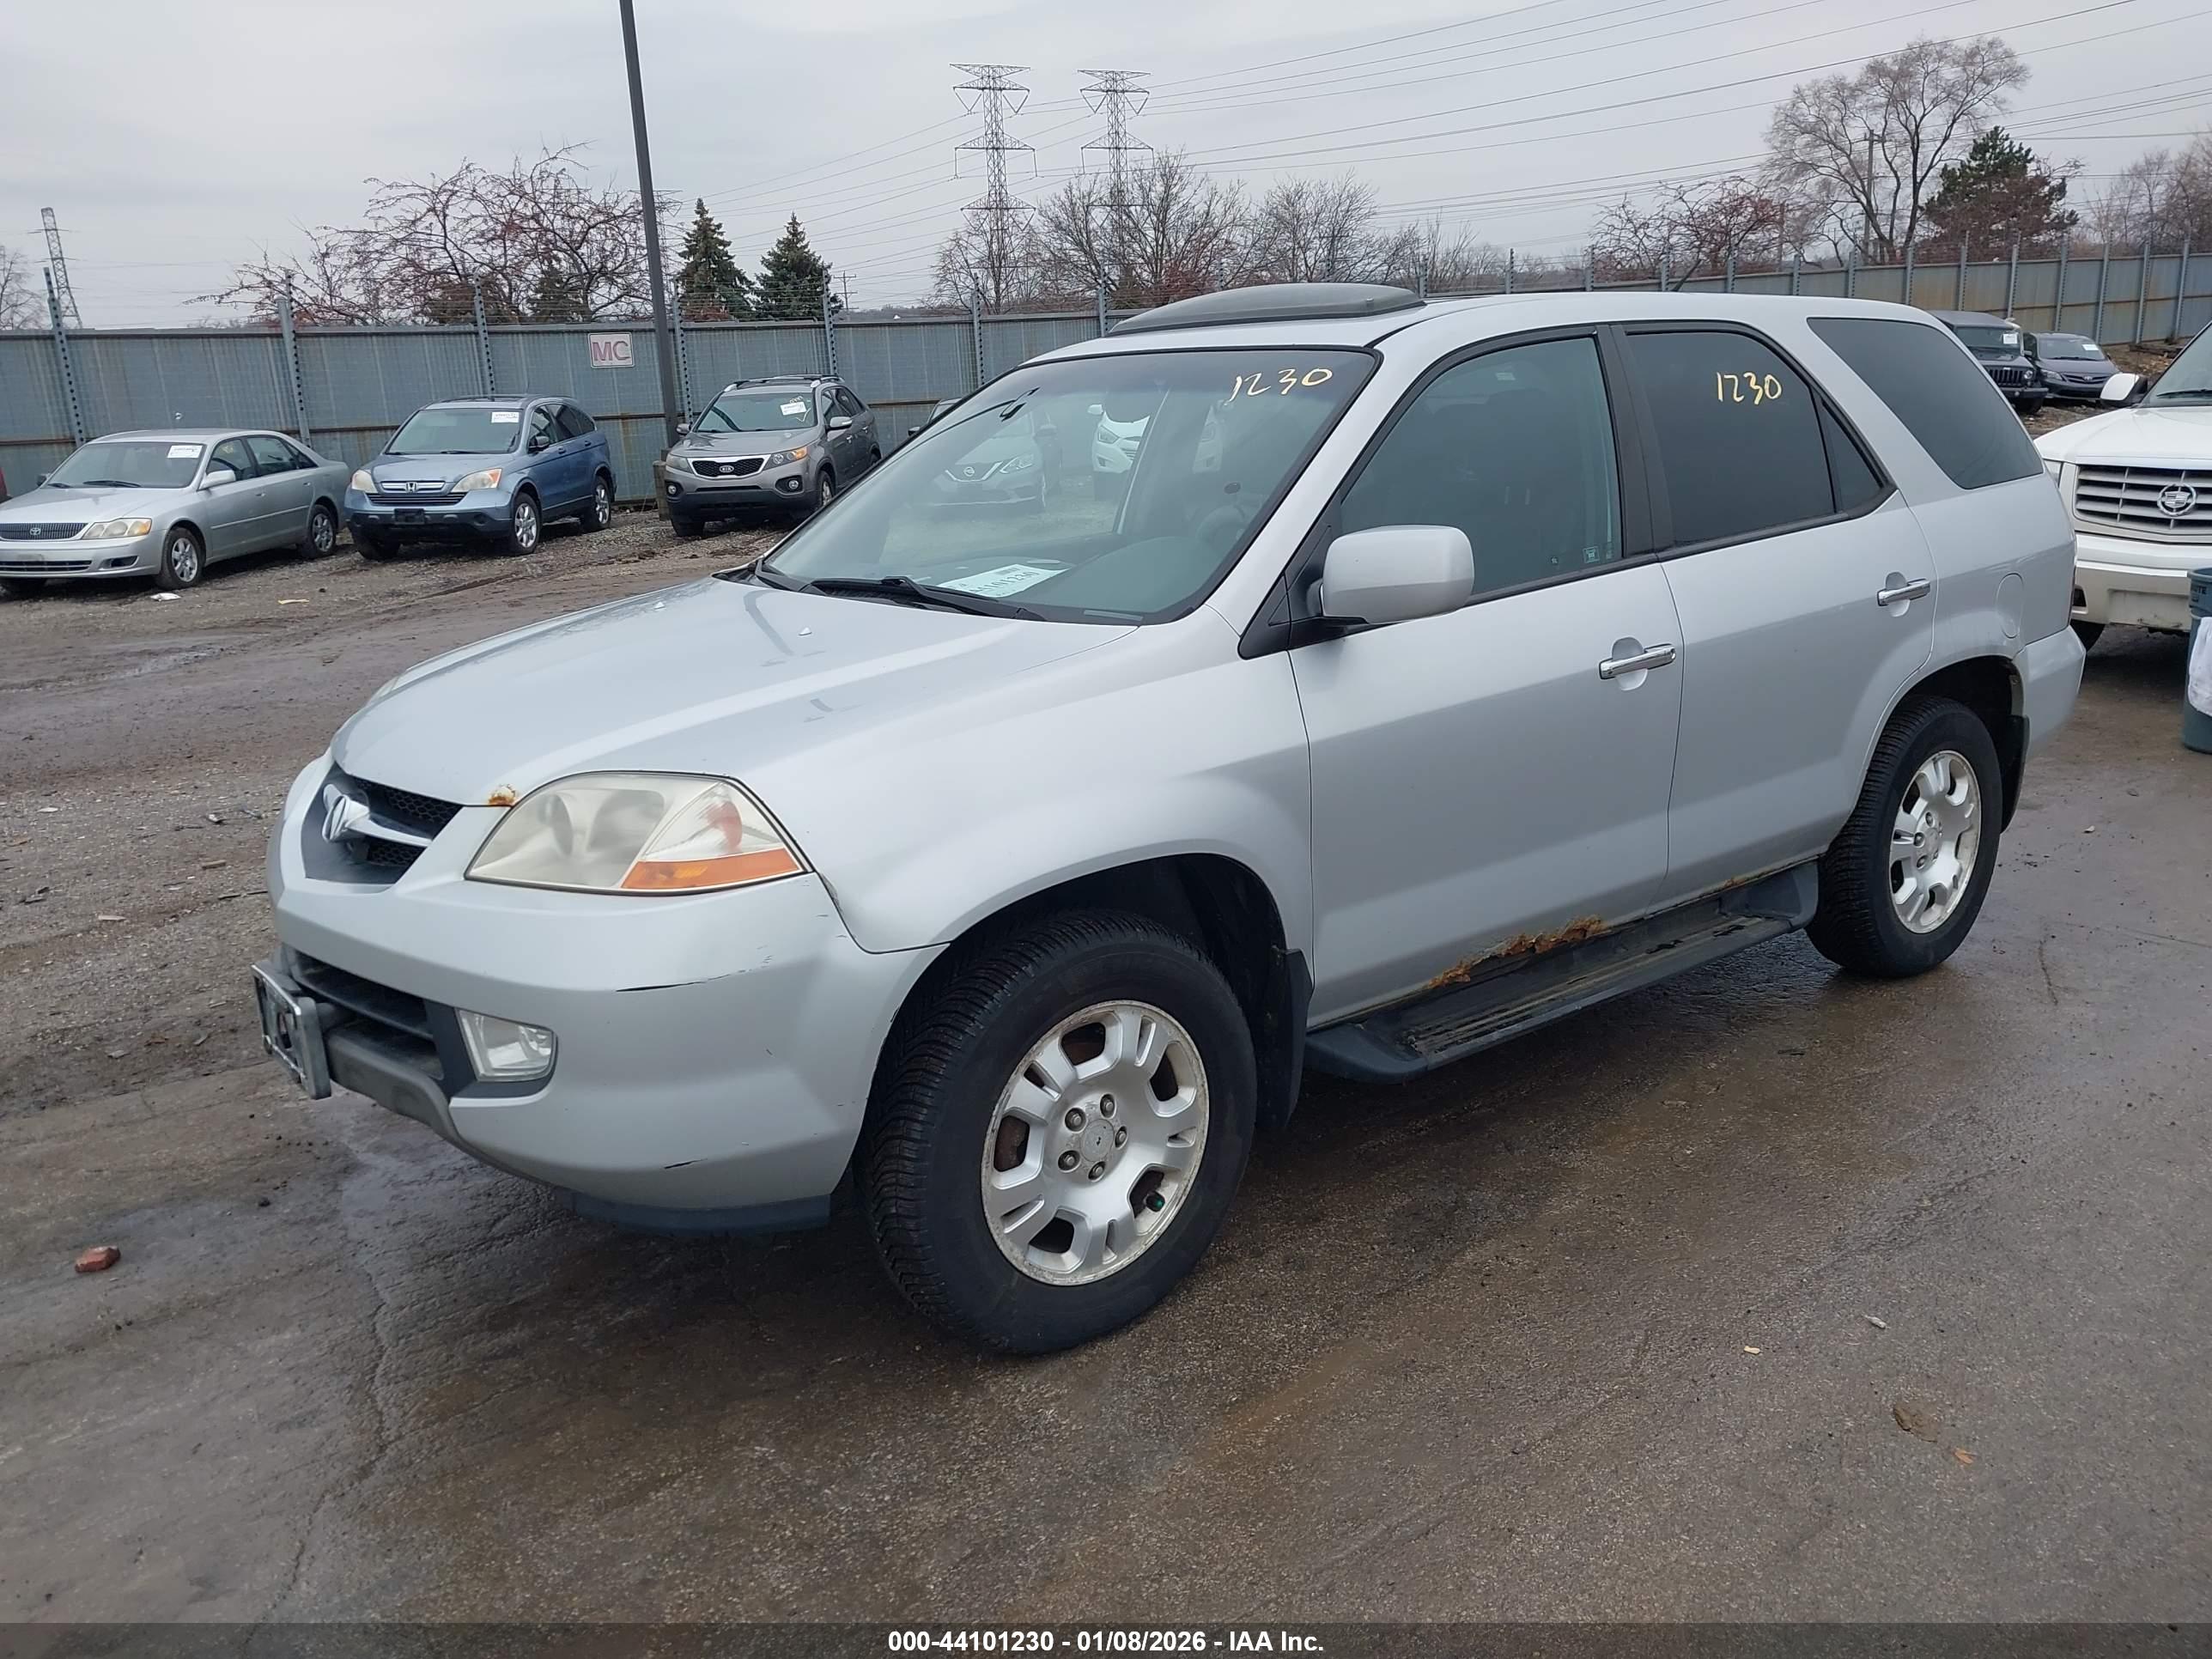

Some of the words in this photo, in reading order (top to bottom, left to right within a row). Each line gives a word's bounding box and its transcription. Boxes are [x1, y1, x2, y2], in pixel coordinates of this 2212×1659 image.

[592, 341, 631, 362] MC
[1224, 368, 1334, 405] 1230
[1716, 371, 1783, 405] 1230
